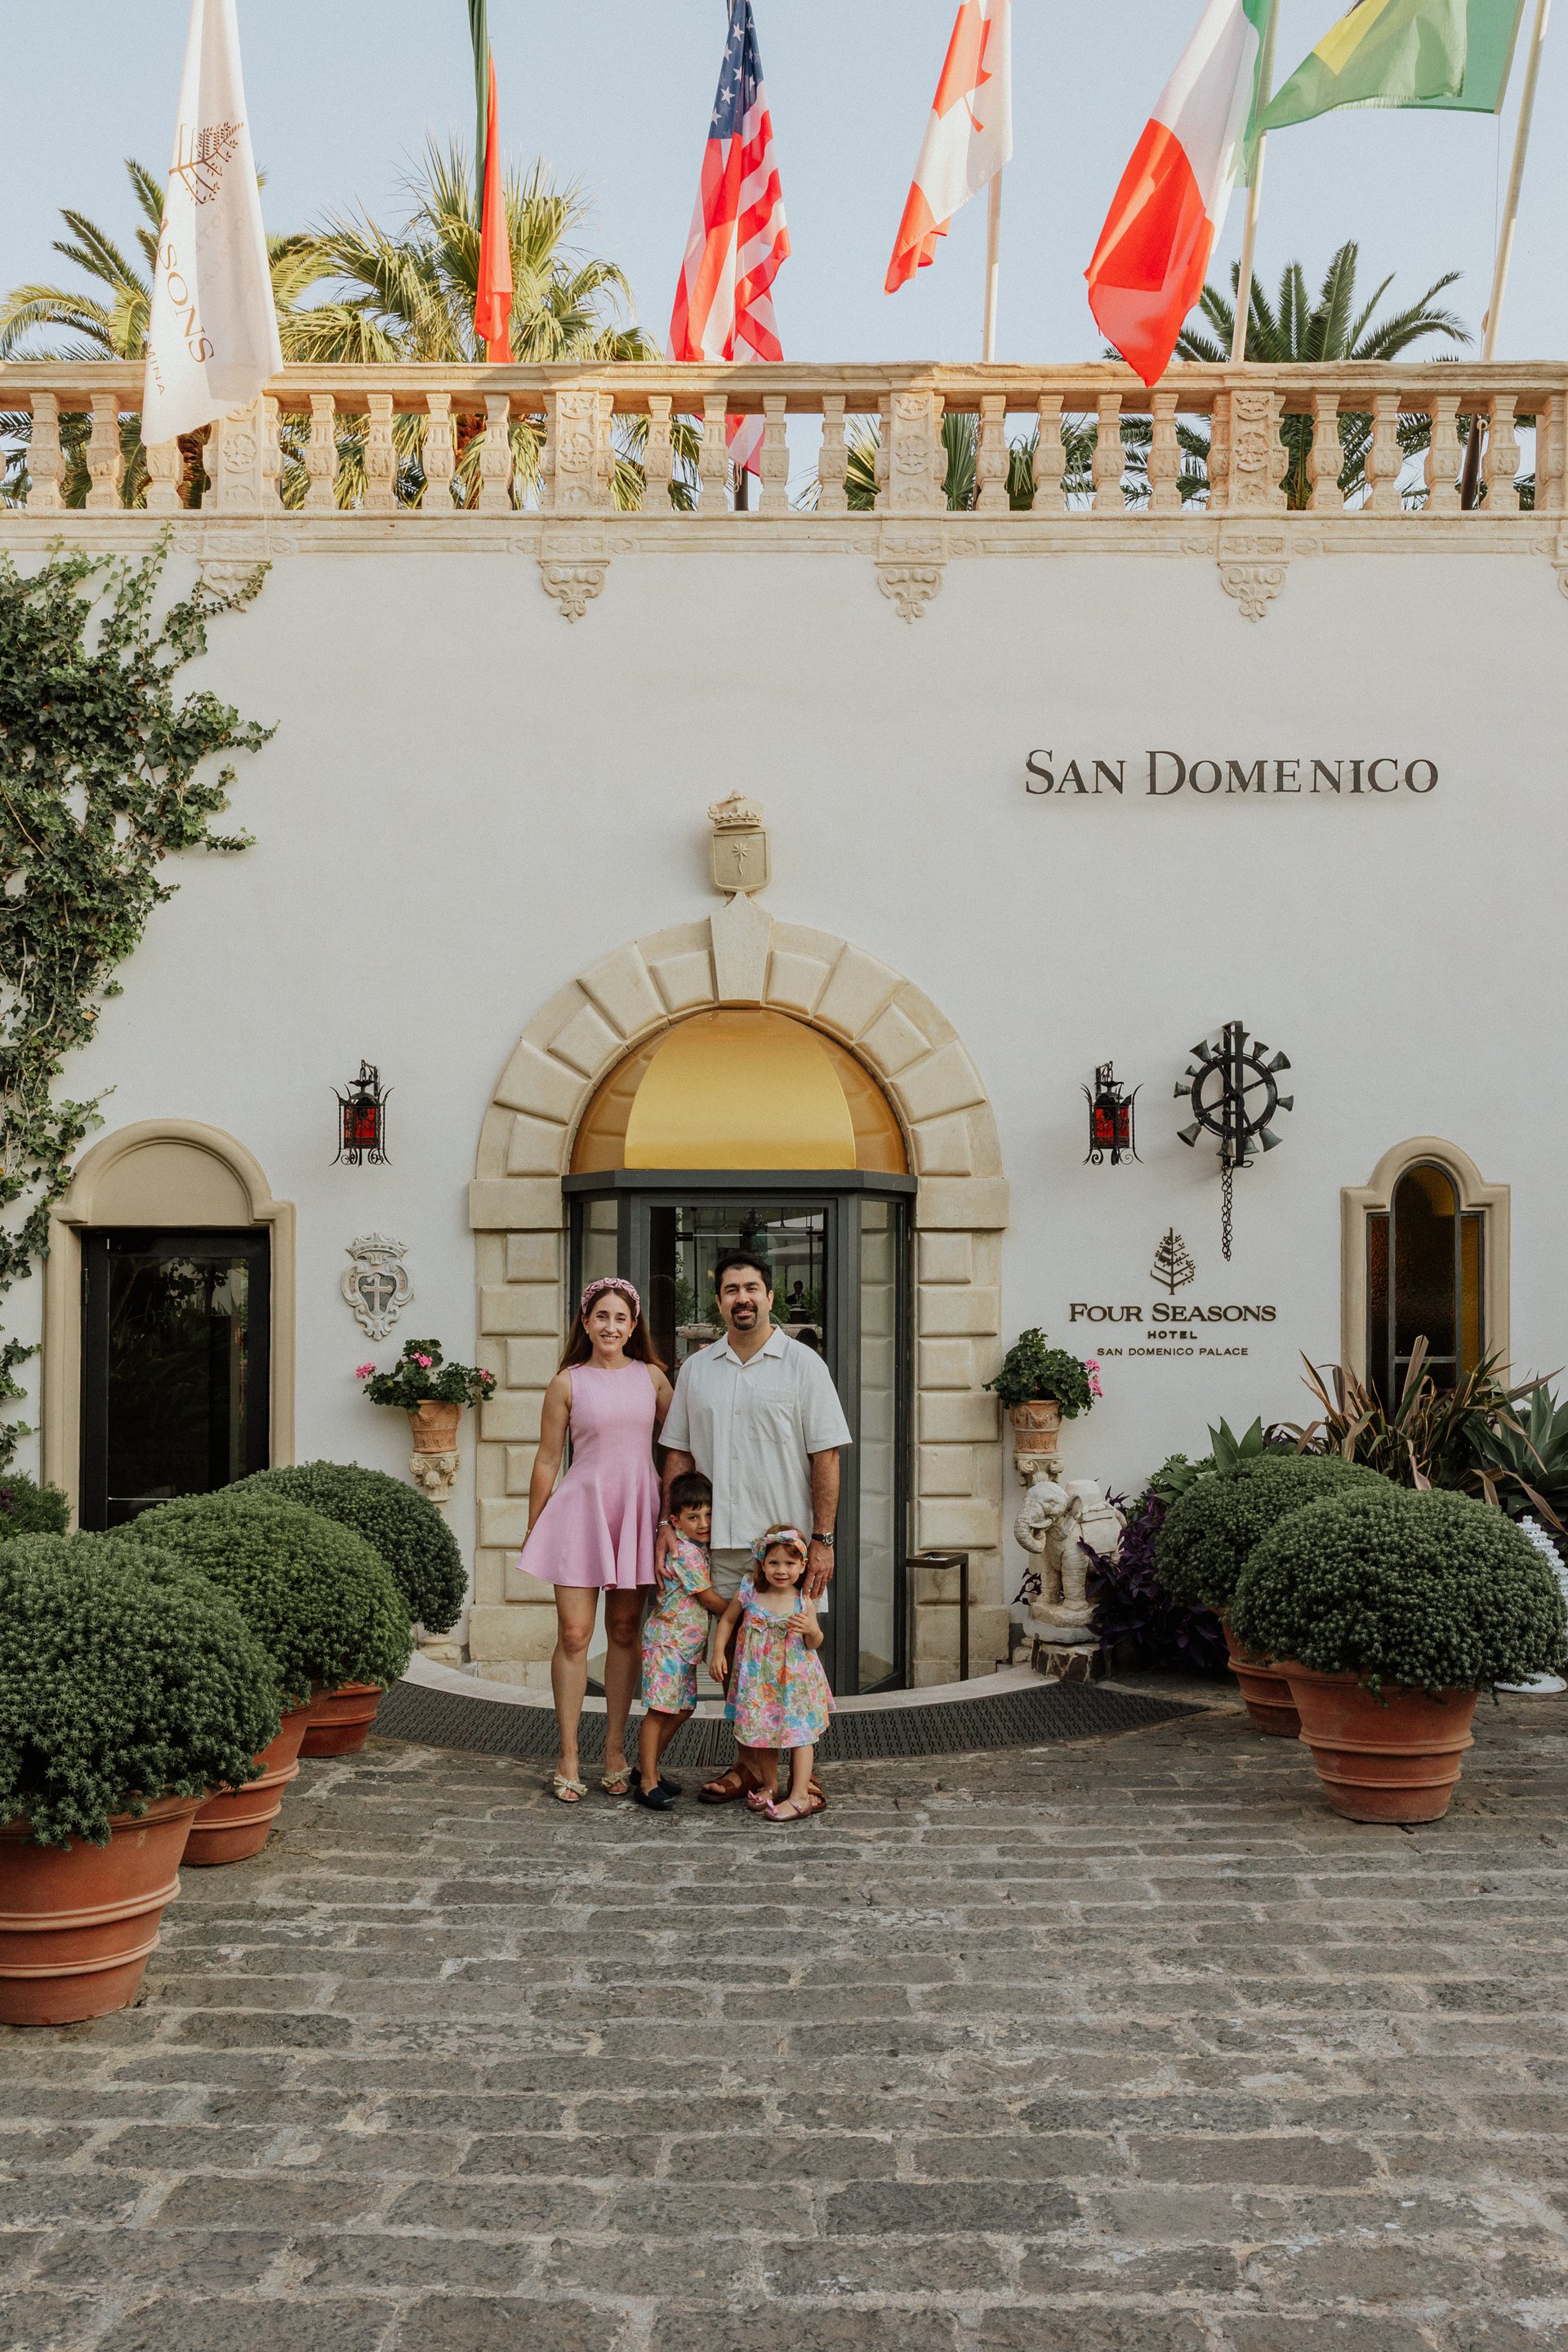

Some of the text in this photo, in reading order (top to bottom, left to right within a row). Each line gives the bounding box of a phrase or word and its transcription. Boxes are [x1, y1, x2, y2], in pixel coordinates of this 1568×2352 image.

[1026, 749, 1439, 795] SAN DOMENICO
[1069, 1302, 1276, 1322] FOUR SEASONS
[1147, 1330, 1198, 1340] HOTEL
[1097, 1348, 1249, 1356] SAN DOMENICO PALACE
